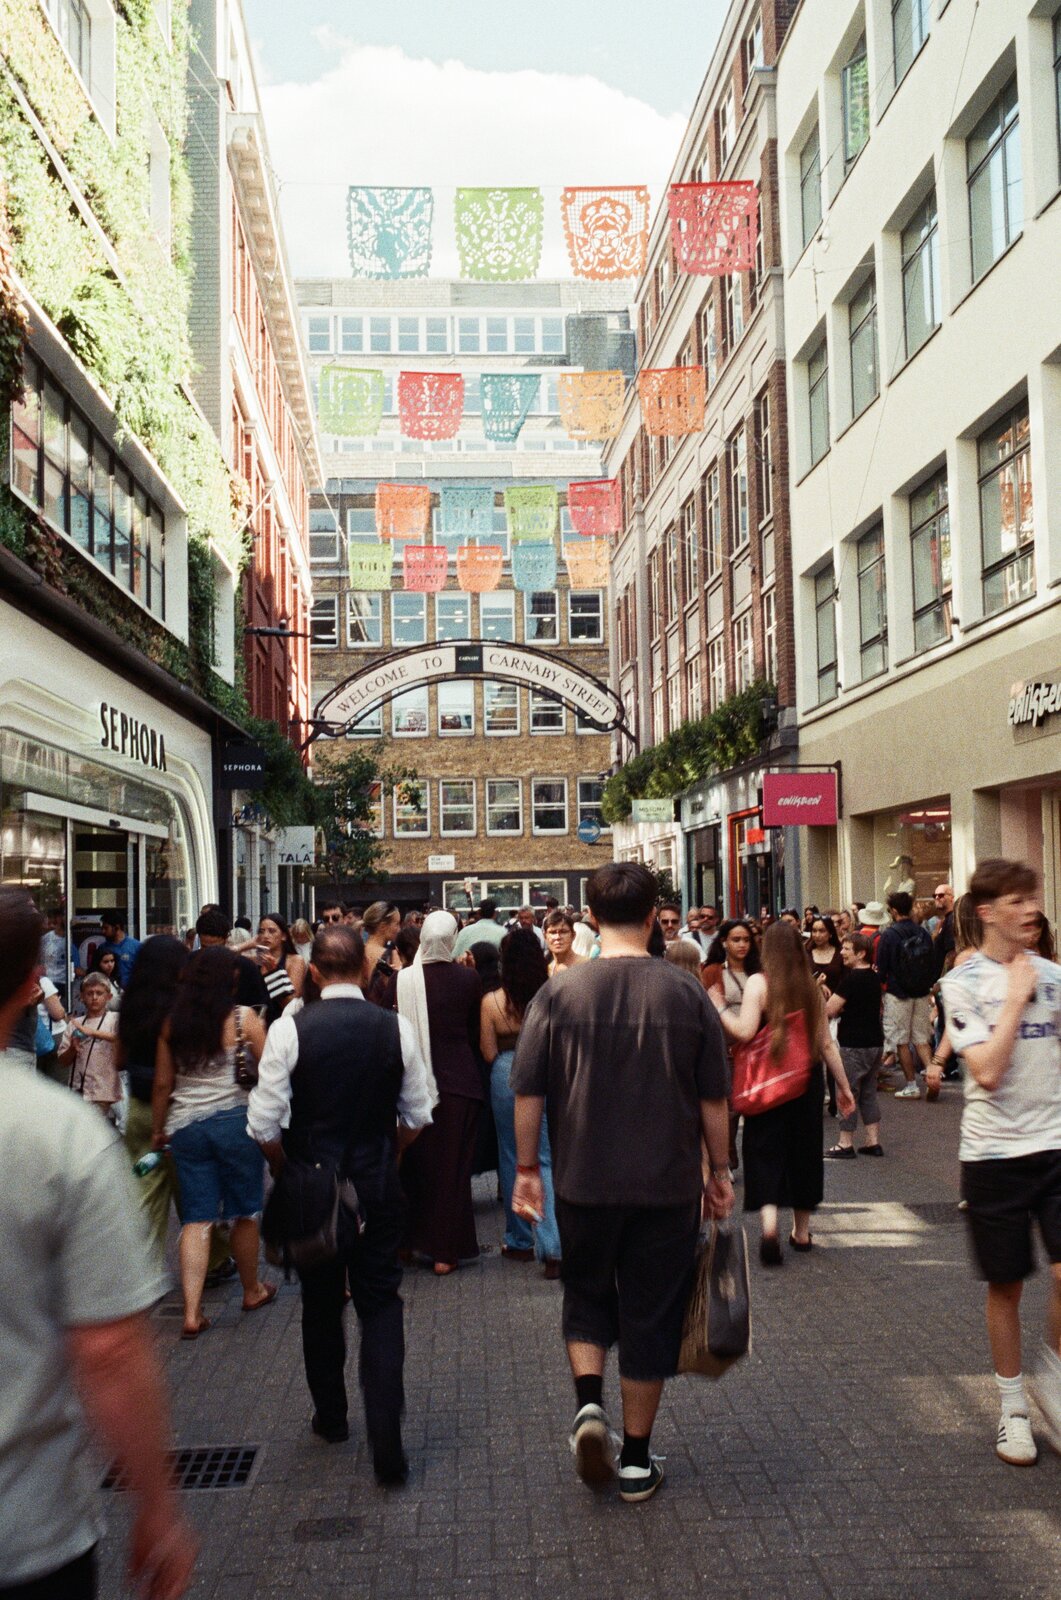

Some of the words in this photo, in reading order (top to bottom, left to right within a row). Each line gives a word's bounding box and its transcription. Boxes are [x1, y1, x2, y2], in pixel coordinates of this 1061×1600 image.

[337, 665, 409, 712] WELCOME
[421, 656, 442, 670] TO
[489, 653, 560, 681] CARNABY
[562, 678, 612, 716] STREET
[101, 702, 167, 772] SEPHORA
[279, 853, 312, 863] TALA
